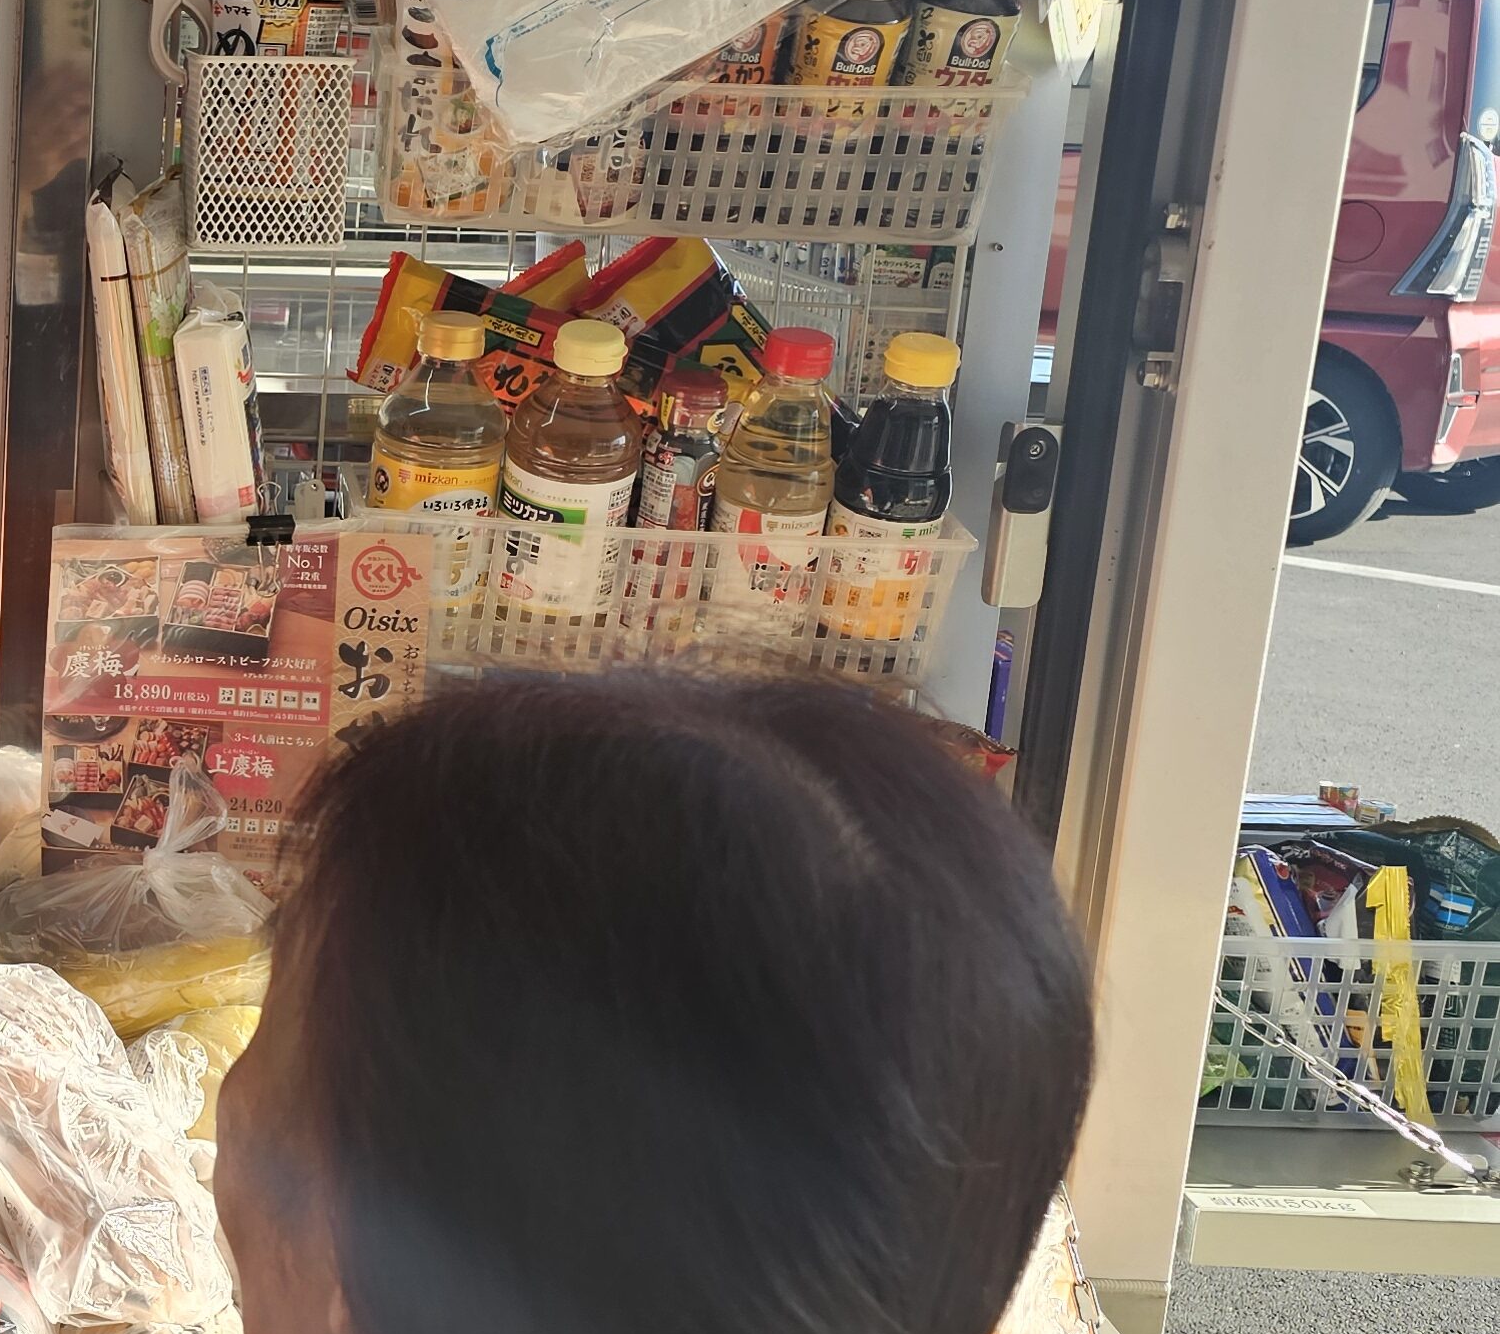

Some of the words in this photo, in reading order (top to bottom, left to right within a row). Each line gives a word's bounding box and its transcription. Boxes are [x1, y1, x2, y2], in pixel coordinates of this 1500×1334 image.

[224, 5, 252, 17] ヤマキ
[720, 51, 761, 64] Bull-Dog
[950, 55, 991, 69] Bull-Dog
[835, 61, 875, 75] Bull-Dog
[414, 472, 459, 486] mizkan
[423, 496, 488, 511] いろいろ使える
[503, 491, 554, 523] ミツカン
[287, 555, 324, 569] No.1
[291, 572, 321, 582] 二段重
[343, 606, 419, 634] Oisix
[61, 650, 123, 678] 慶梅
[150, 654, 317, 670] やわらかローストビーフが大好評
[403, 644, 420, 708] おせち
[208, 753, 275, 779] 上慶梅
[230, 797, 283, 815] 24,620
